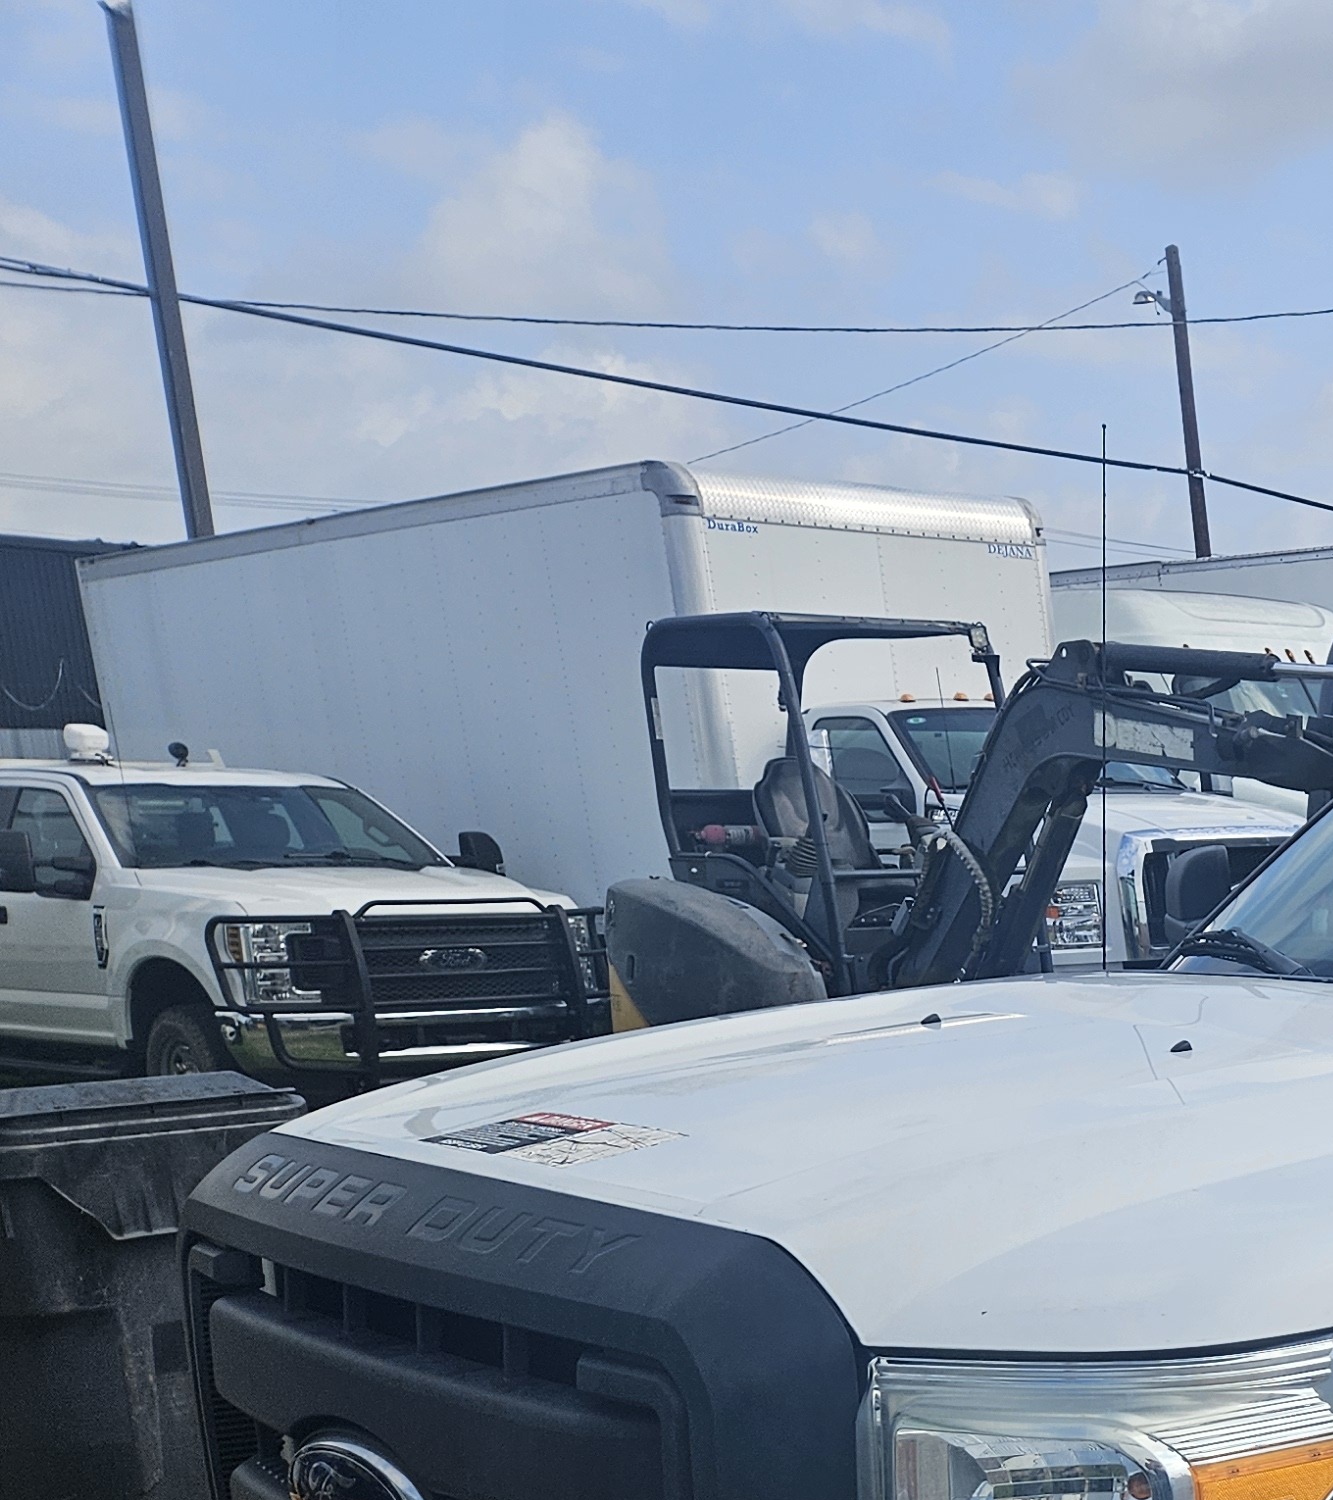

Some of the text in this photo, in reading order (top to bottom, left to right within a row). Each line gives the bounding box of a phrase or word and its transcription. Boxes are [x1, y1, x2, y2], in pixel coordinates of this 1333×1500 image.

[707, 517, 758, 533] DuraBox
[988, 543, 1032, 559] DEJANA
[233, 1152, 643, 1275] SUPER DUTY
